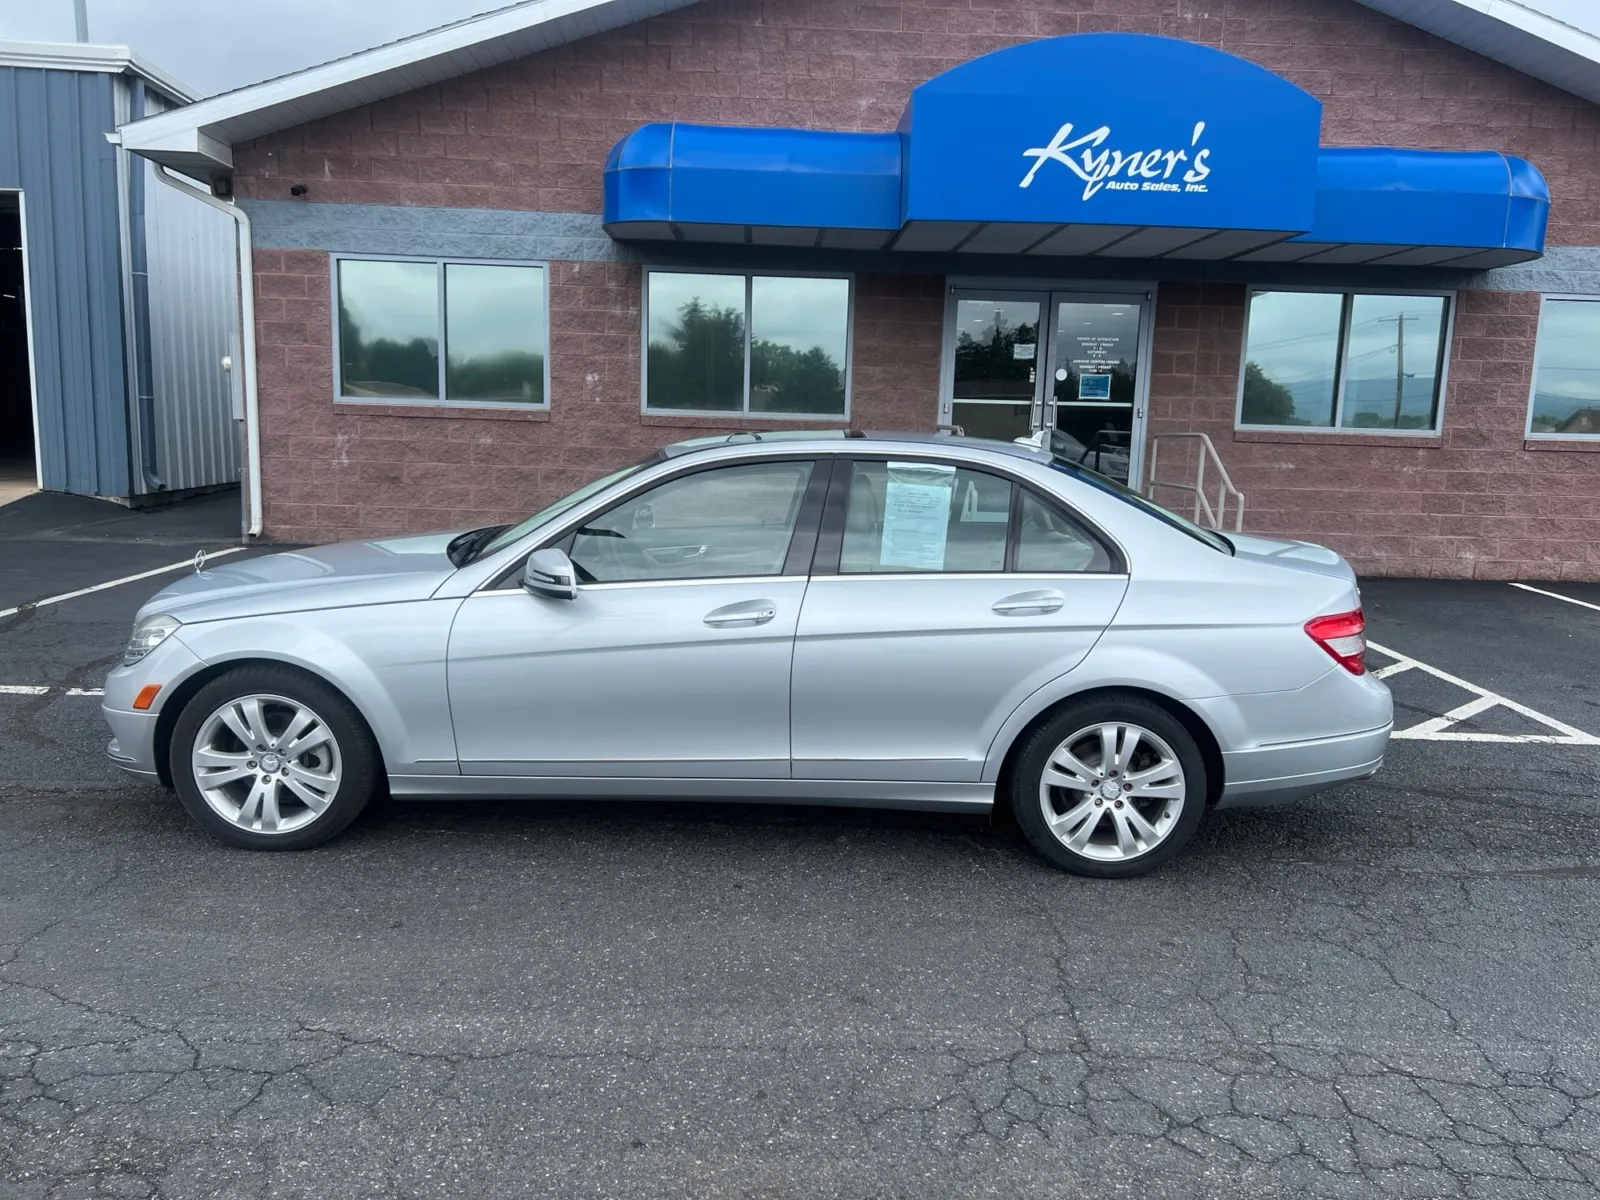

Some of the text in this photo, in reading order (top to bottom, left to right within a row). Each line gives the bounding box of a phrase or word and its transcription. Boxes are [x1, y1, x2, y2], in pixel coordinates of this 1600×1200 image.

[1019, 121, 1211, 201] Kyner's
[1105, 181, 1209, 193] Auto Sales, Inc.
